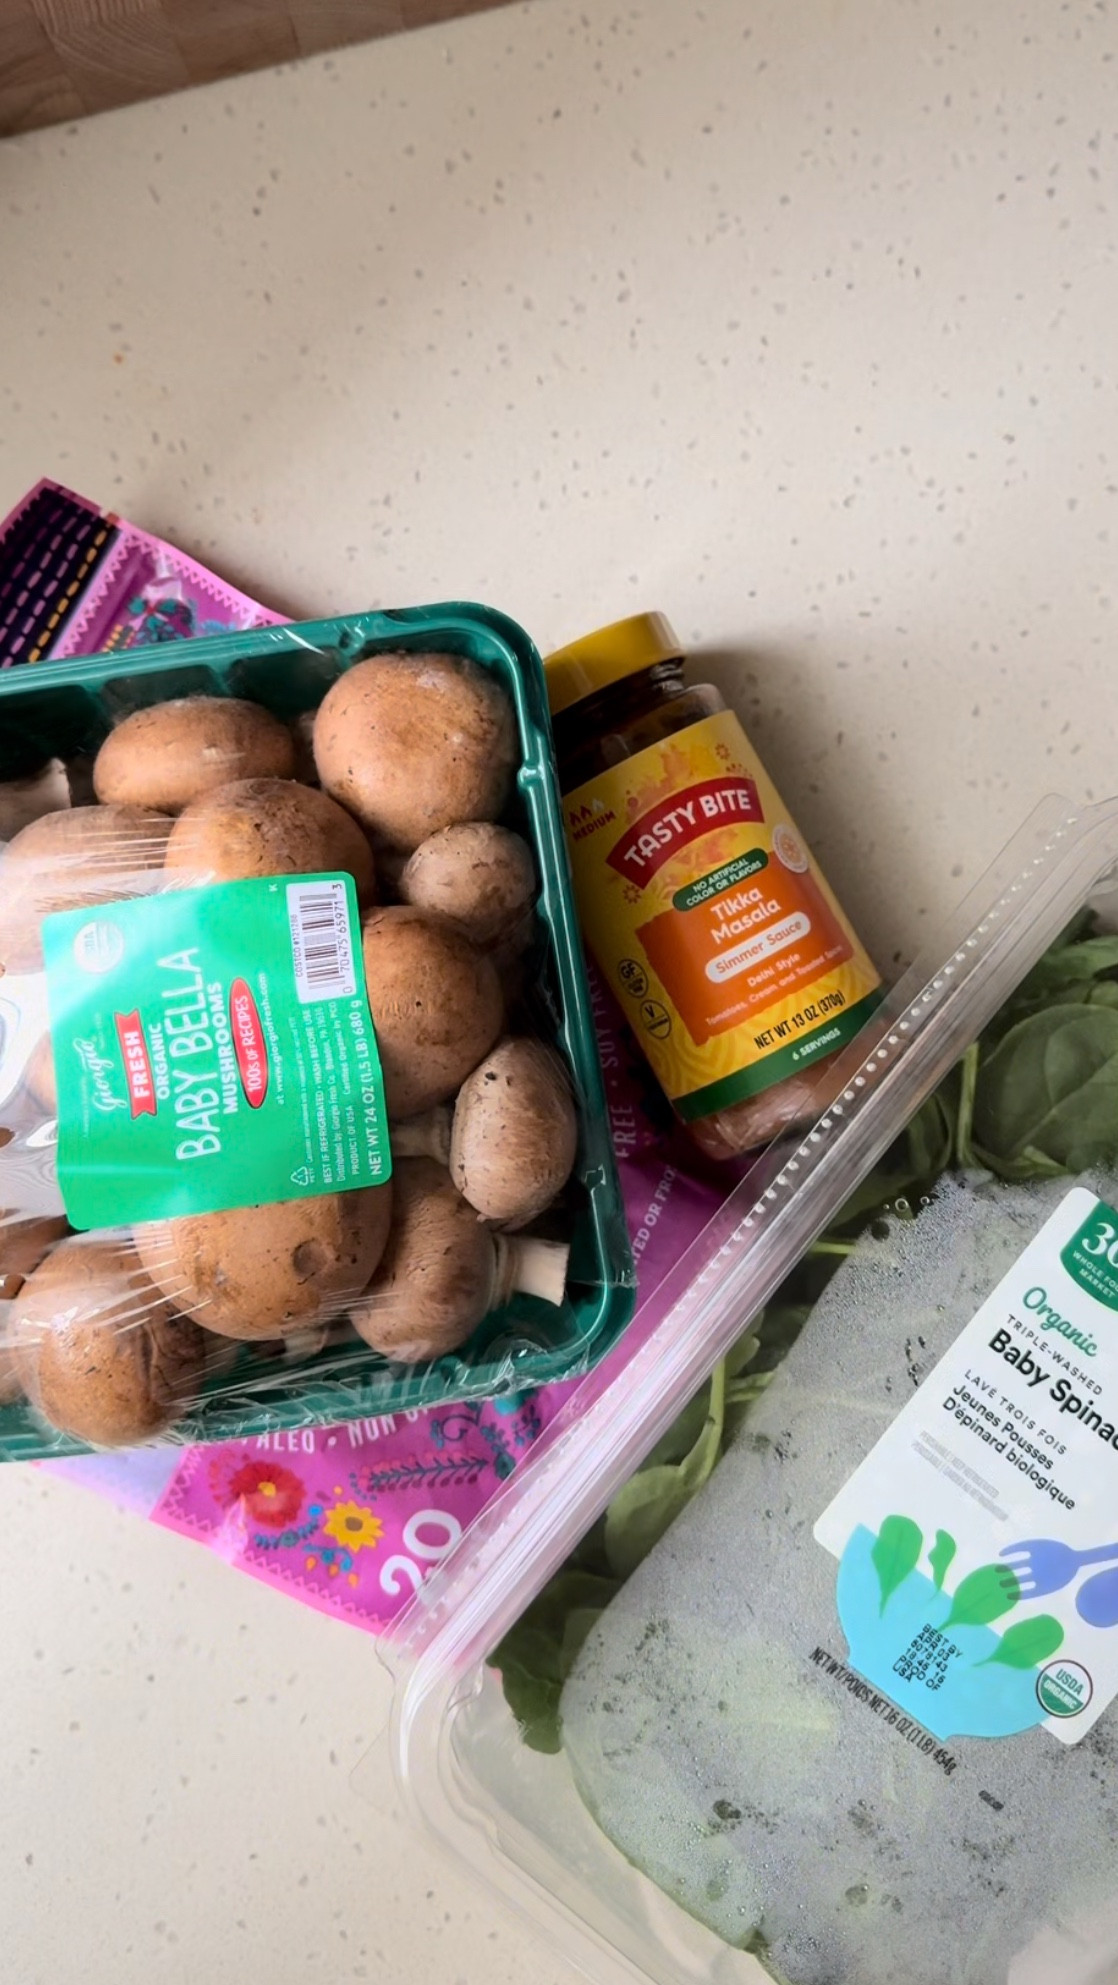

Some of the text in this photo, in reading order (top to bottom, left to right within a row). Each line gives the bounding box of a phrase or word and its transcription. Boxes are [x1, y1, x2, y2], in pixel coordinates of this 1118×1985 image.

[572, 810, 617, 842] MEDIUM
[624, 789, 752, 867] TASTY BITE
[685, 860, 762, 907] COLOR OR FLAVORS
[693, 858, 749, 892] NO ARTIFICIAL
[334, 899, 347, 934] 65971
[710, 887, 763, 921] Tikka
[710, 899, 782, 945] Masala
[293, 946, 303, 978] COSTCO
[337, 938, 350, 973] 70475
[715, 921, 802, 974] Simmer Sauce
[342, 986, 353, 994] 0
[747, 953, 801, 988] Delhi Style
[749, 983, 778, 1003] Cream
[779, 972, 796, 987] and
[644, 1003, 655, 1018] V
[754, 989, 846, 1050] NET WT 13 OZ (370g)
[156, 947, 222, 1160] BABY BELLA
[206, 981, 238, 1115] MUSHROOMS
[234, 994, 263, 1092] 100s OF RECIPES
[258, 972, 285, 1106] at www.giorgiofresh.com
[335, 1029, 347, 1061] Organic
[792, 1027, 842, 1062] 6 SERVINGS
[72, 1037, 128, 1111] Giorgio
[124, 1031, 150, 1099] FRESH
[149, 1022, 170, 1100] ORGANIC
[302, 1009, 333, 1184] BEST IF REFRIGERATED WASH BEFORE USE
[329, 1085, 337, 1104] Fresh
[349, 1000, 383, 1176] NET WT 24 OZ (1.5 LB) 680 g
[346, 1105, 359, 1175] PRODUCT OF USA
[644, 1203, 663, 1227] OR
[1073, 1250, 1105, 1277] WHOLE
[1079, 1267, 1116, 1298] MARKET
[1022, 1286, 1099, 1357] Organic
[988, 1327, 1051, 1388] Baby
[1006, 1314, 1103, 1396] TRIPLE-WASHED
[240, 1415, 397, 1454] ALEO NON
[953, 1385, 1054, 1470] Jeunes Pousses
[999, 1397, 1037, 1430] TROIS
[1037, 1428, 1068, 1456] FOIS
[1005, 1447, 1076, 1510] biologique
[380, 1509, 462, 1597] 20
[916, 1632, 951, 1661] APR 03
[922, 1622, 964, 1658] BEST BY
[892, 1659, 913, 1683] USA
[899, 1655, 941, 1691] PROD OF
[1056, 1668, 1084, 1696] USDA
[808, 1646, 831, 1669] NET
[870, 1693, 889, 1716] NET
[883, 1708, 899, 1725] 16
[895, 1717, 913, 1736] OZ
[916, 1733, 937, 1756] LB)
[933, 1748, 958, 1776] 454g
[1043, 1679, 1077, 1710] ORGANIC
